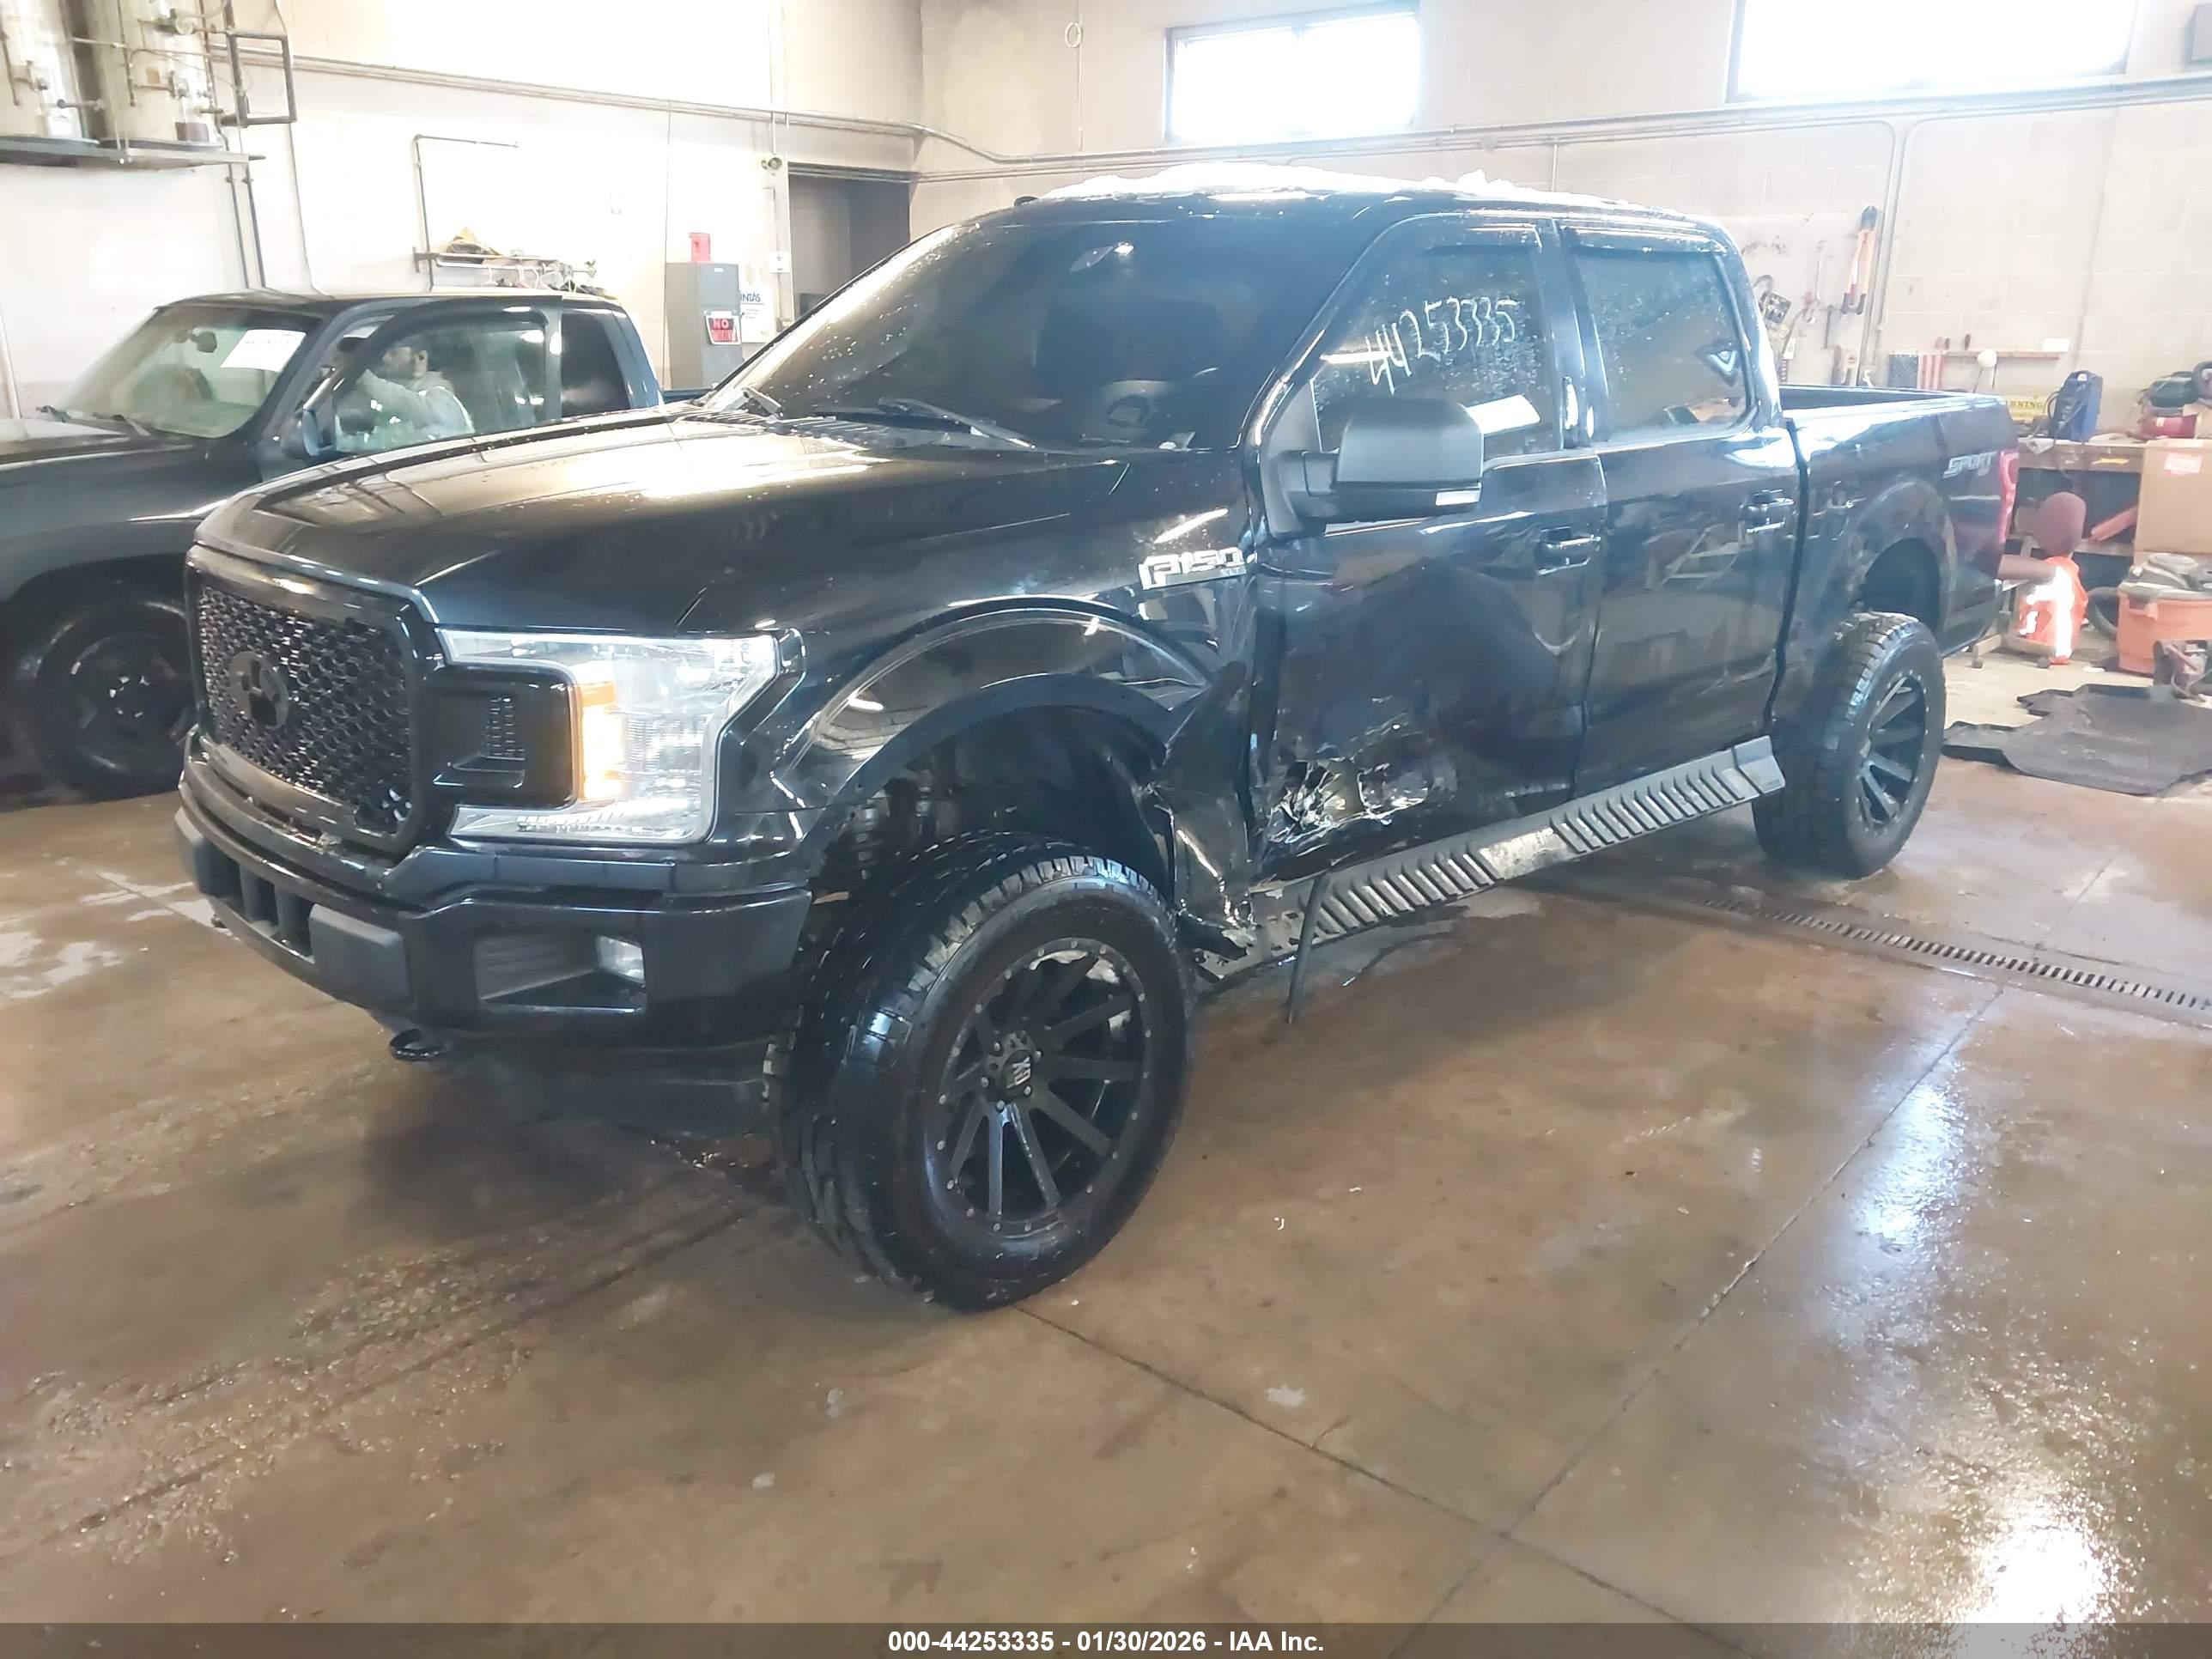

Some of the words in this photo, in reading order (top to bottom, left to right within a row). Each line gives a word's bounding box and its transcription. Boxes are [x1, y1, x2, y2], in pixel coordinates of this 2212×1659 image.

[742, 292, 762, 303] NTAS
[714, 318, 730, 329] NO
[1365, 295, 1519, 395] 44253335
[2010, 400, 2044, 409] RNING
[1942, 452, 1997, 477] SPORT
